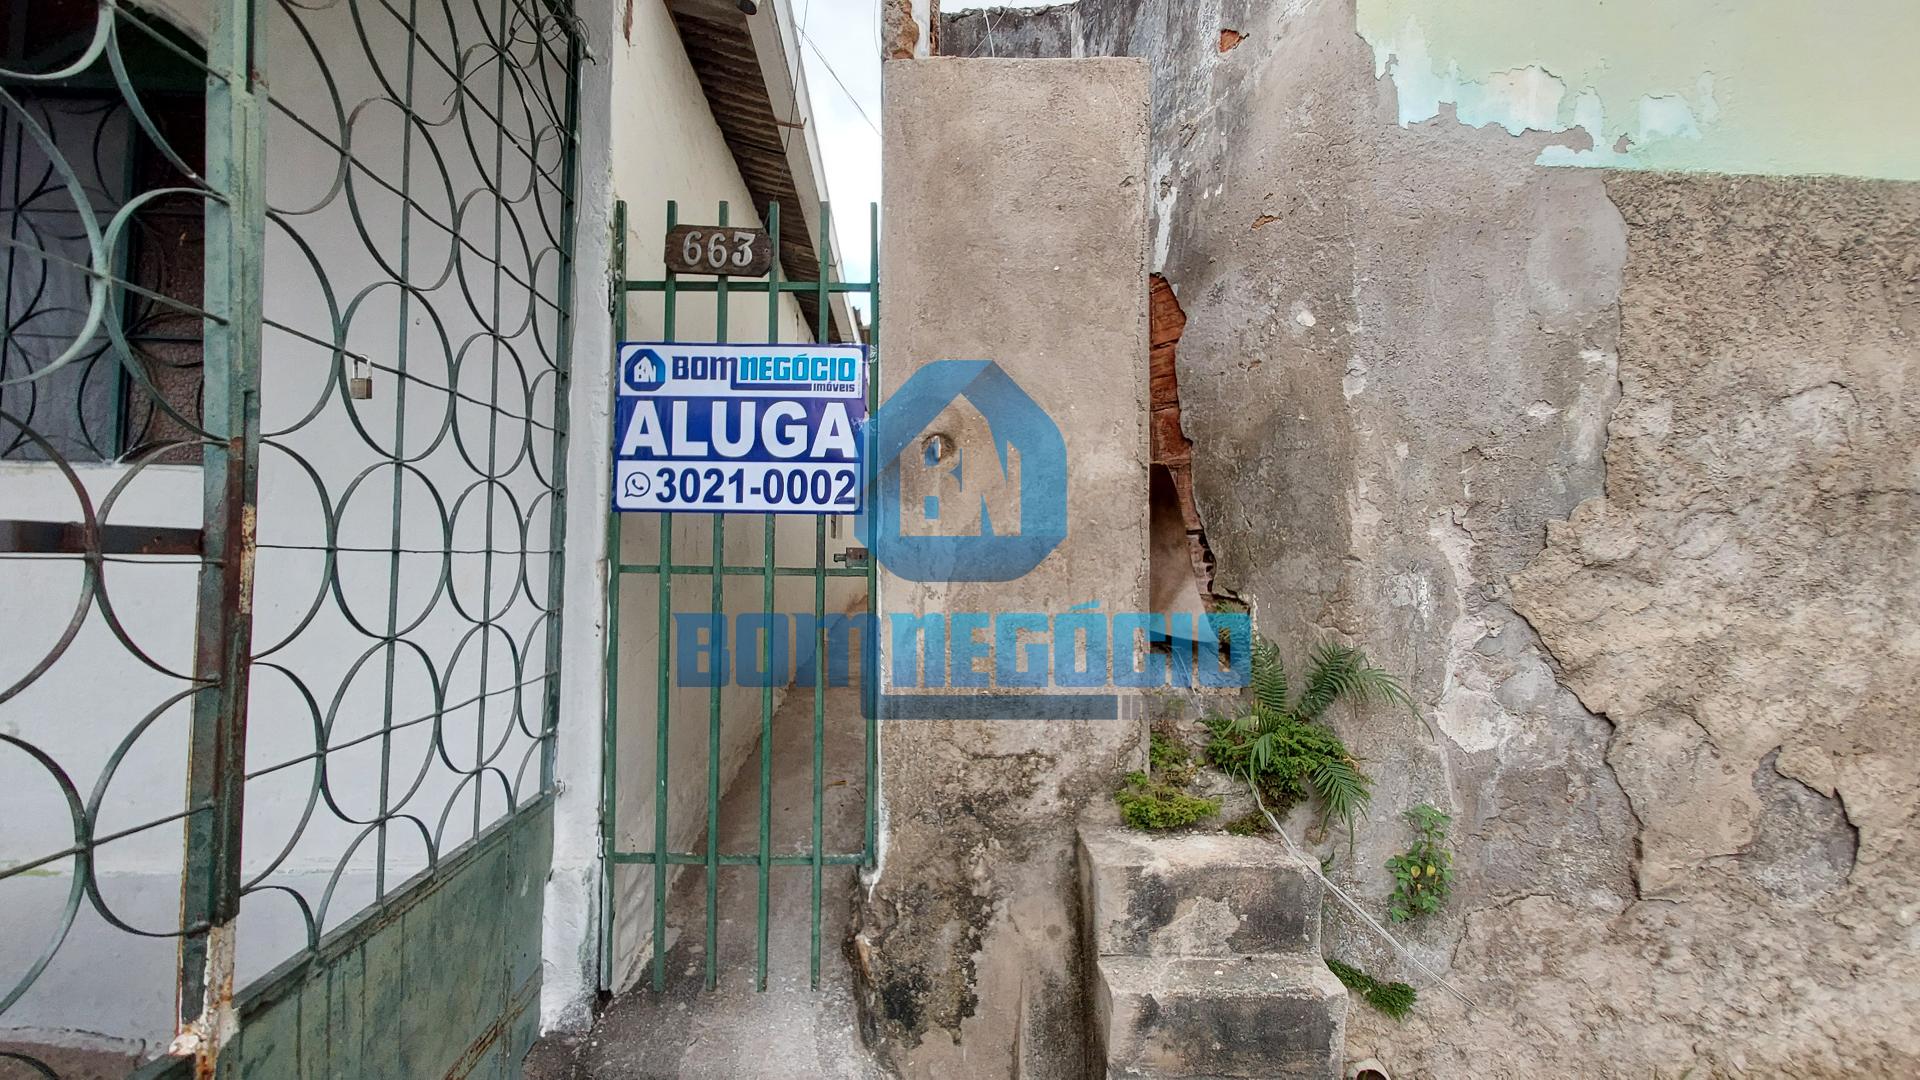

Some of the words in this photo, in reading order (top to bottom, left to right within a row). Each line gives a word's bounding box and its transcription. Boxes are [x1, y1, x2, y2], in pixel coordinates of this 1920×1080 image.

[682, 231, 756, 268] 663
[620, 400, 859, 458] ALUGA
[655, 467, 856, 505] 3021-0002
